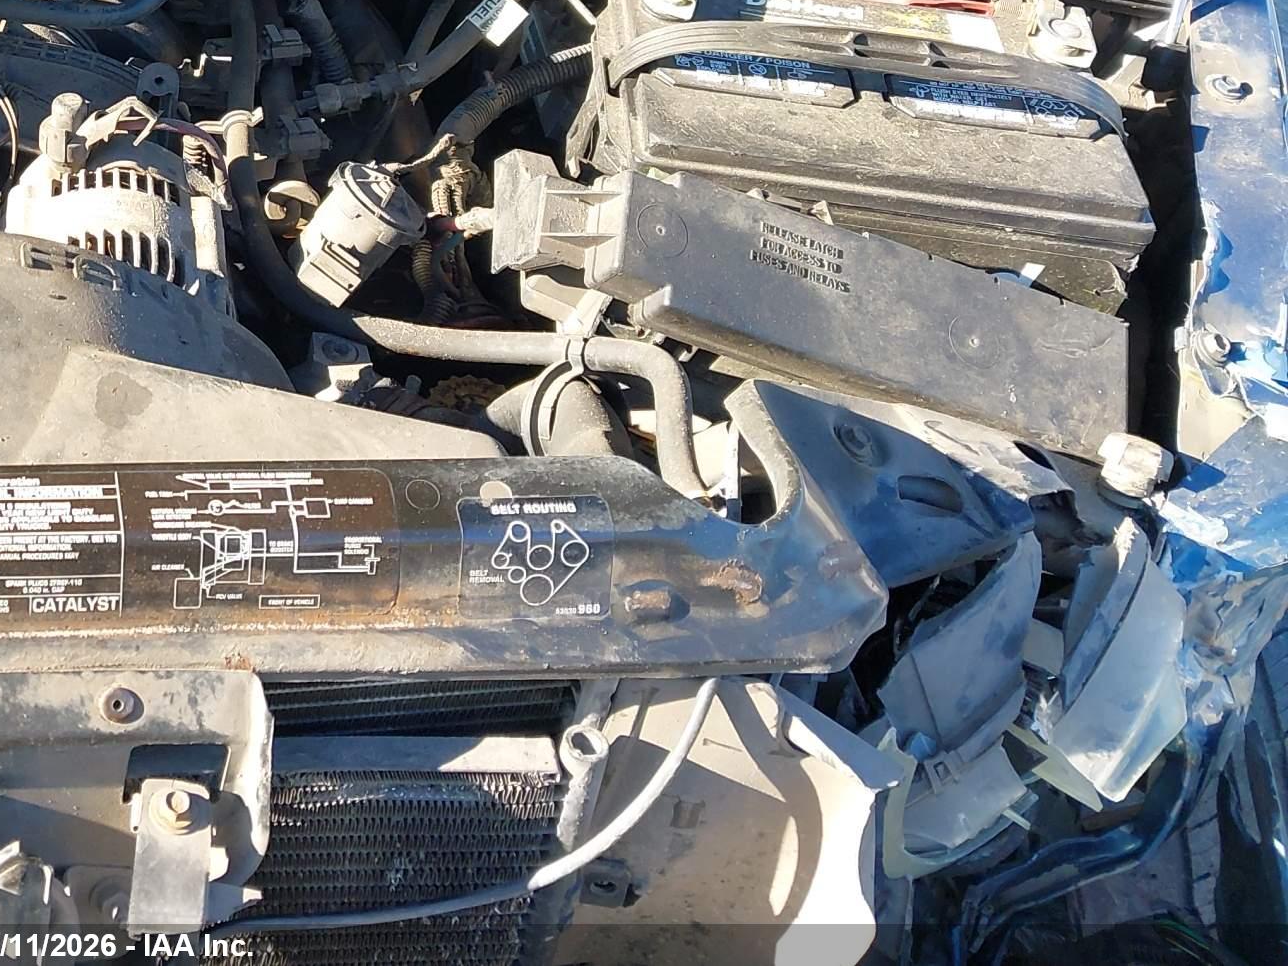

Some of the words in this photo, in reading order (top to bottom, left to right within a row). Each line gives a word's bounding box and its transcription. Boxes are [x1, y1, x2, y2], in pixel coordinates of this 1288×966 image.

[765, 57, 811, 69] POISON
[760, 221, 809, 247] RELEASE
[809, 239, 844, 260] LATCH
[760, 236, 785, 255] FOR
[783, 245, 826, 269] ACCESS
[825, 260, 843, 274] TO
[750, 249, 788, 271] FUSES
[787, 263, 809, 279] AND
[808, 271, 851, 293] RELAYS
[491, 502, 521, 515] BELT
[522, 501, 577, 514] ROUTING
[469, 569, 489, 577] BELT
[469, 575, 505, 584] REMOVAL
[32, 596, 119, 613] CATALYST
